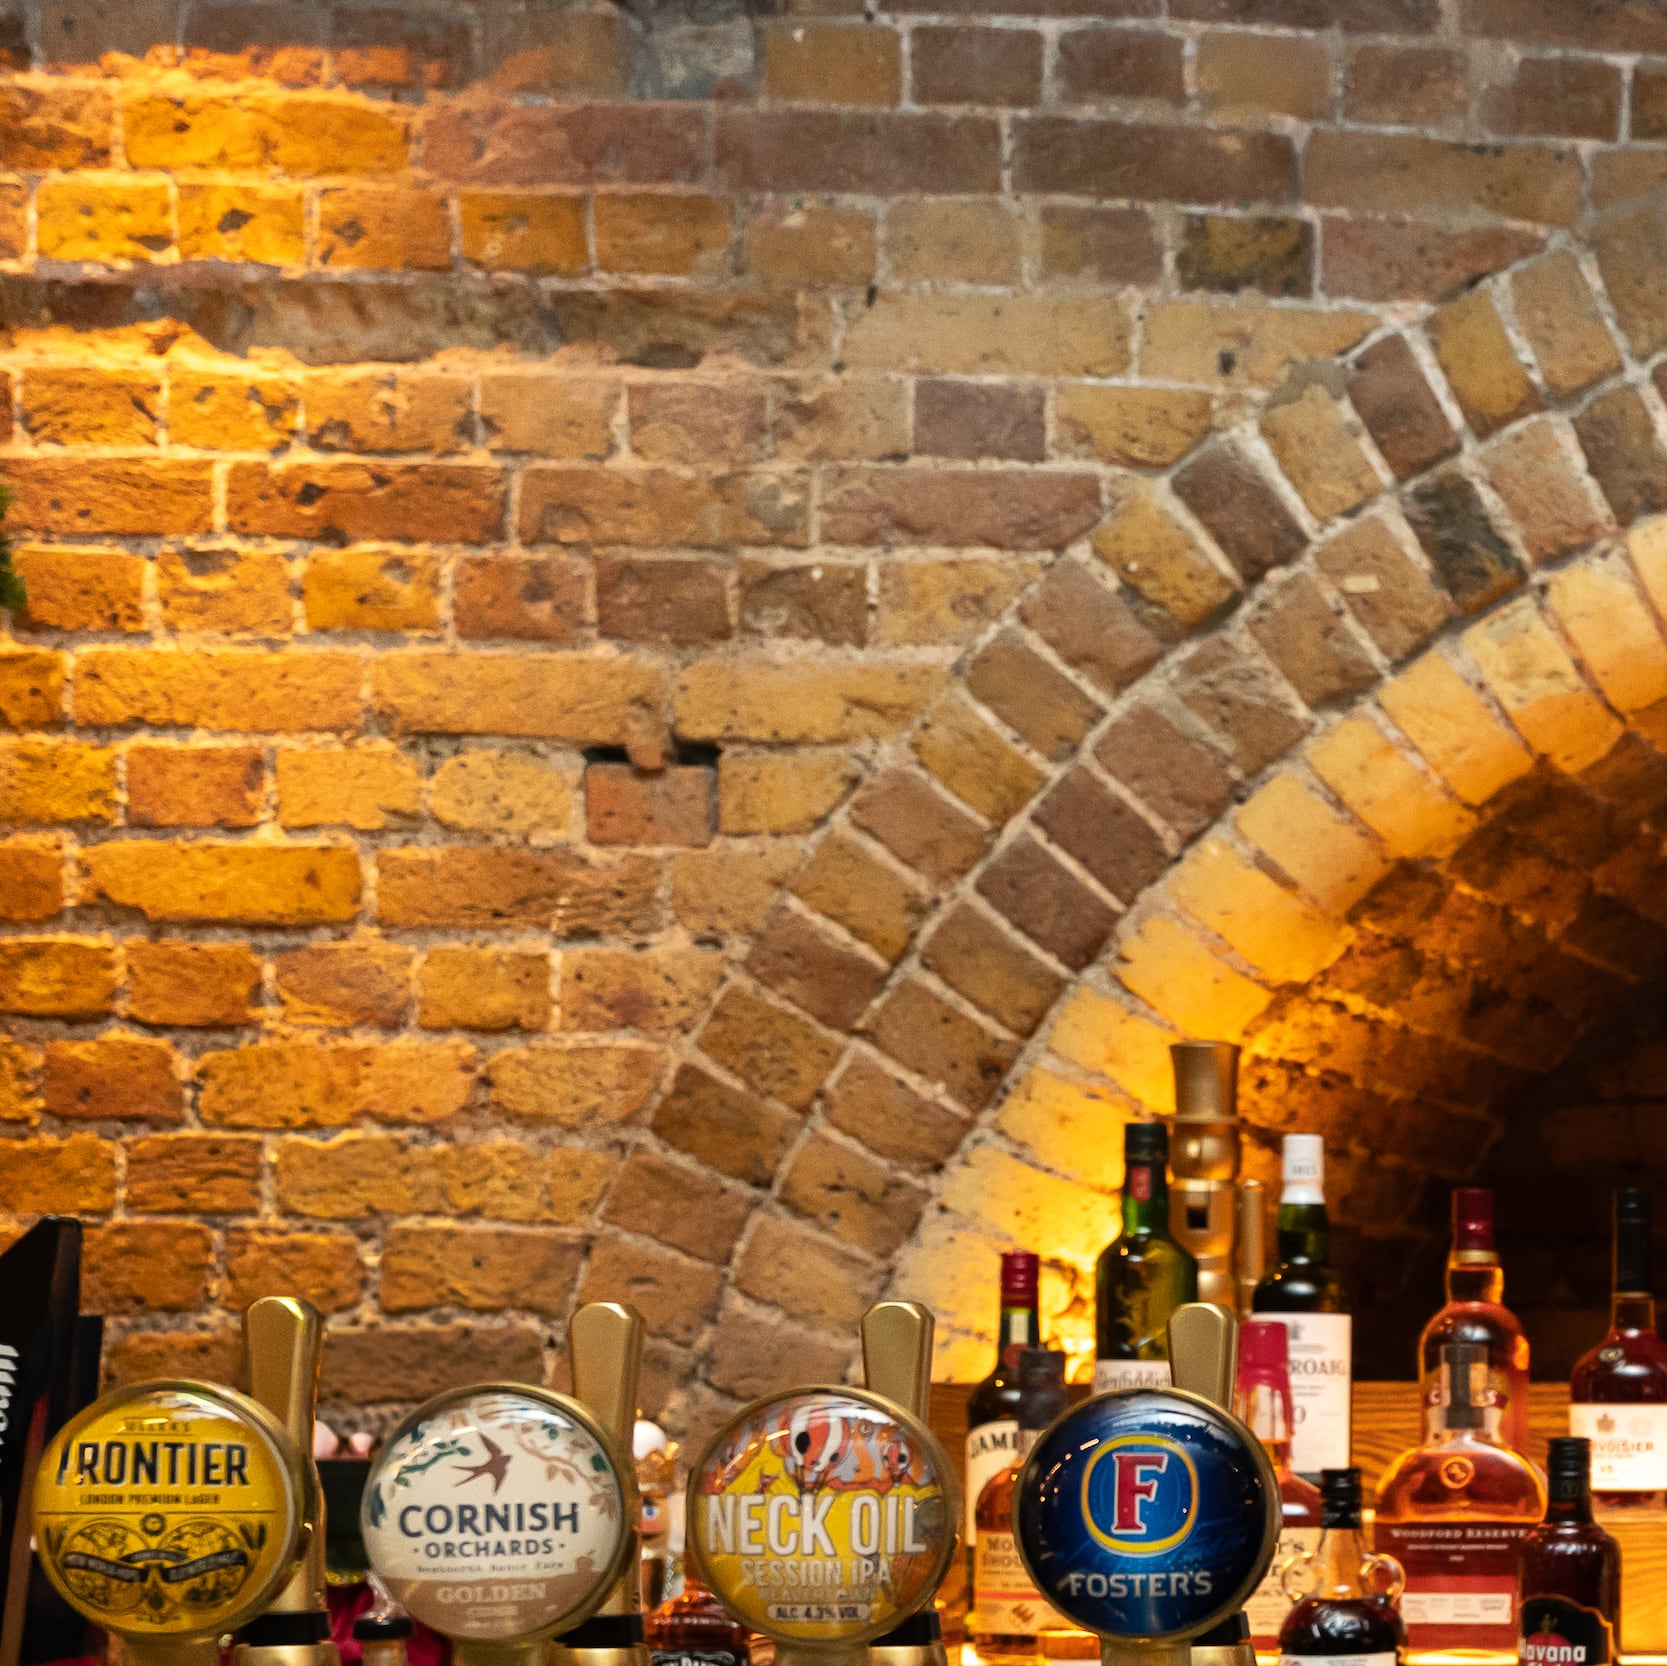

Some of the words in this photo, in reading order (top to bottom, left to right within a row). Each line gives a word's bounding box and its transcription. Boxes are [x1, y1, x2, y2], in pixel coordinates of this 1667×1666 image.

[1289, 1359, 1348, 1377] ROAIG
[1112, 1452, 1168, 1535] F
[399, 1502, 580, 1539] CORNISH
[706, 1493, 837, 1557] NECK
[850, 1494, 928, 1556] OIL
[1390, 1527, 1463, 1540] WOODFORD
[424, 1538, 554, 1560] ORCHARDS
[740, 1558, 843, 1588] SESSION
[852, 1558, 892, 1585] IPA
[1068, 1571, 1213, 1599] FOSTER'S
[435, 1582, 548, 1605] GOLDEN
